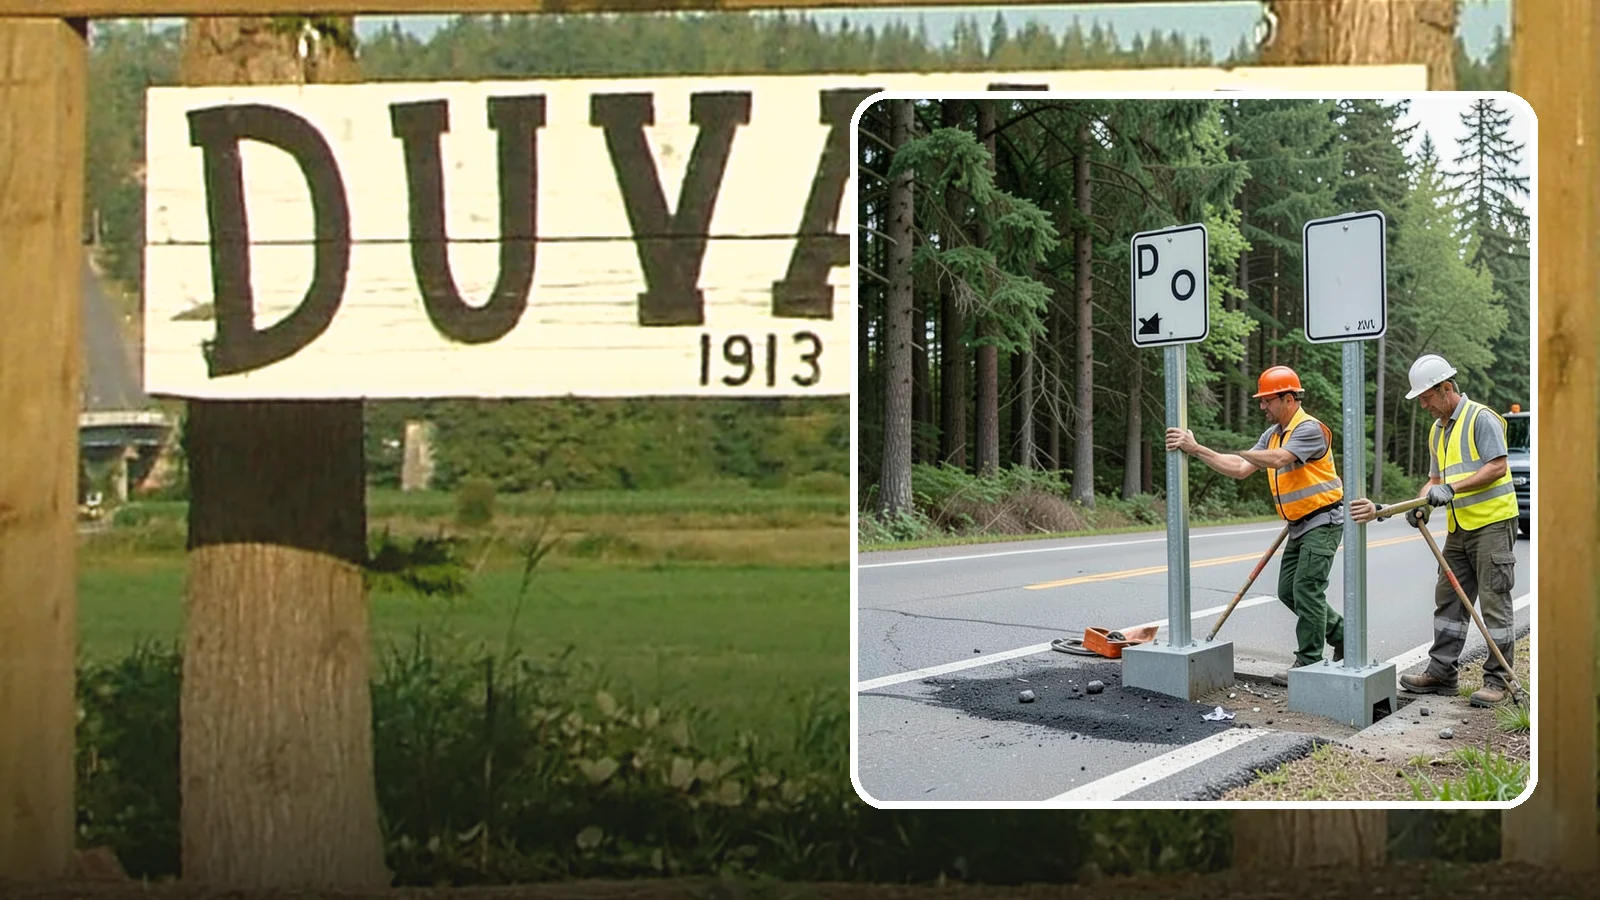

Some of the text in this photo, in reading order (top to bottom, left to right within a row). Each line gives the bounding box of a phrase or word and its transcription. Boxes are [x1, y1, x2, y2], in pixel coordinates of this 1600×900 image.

[1137, 243, 1159, 280] D
[1170, 268, 1196, 302] O
[699, 331, 823, 387] 1913
